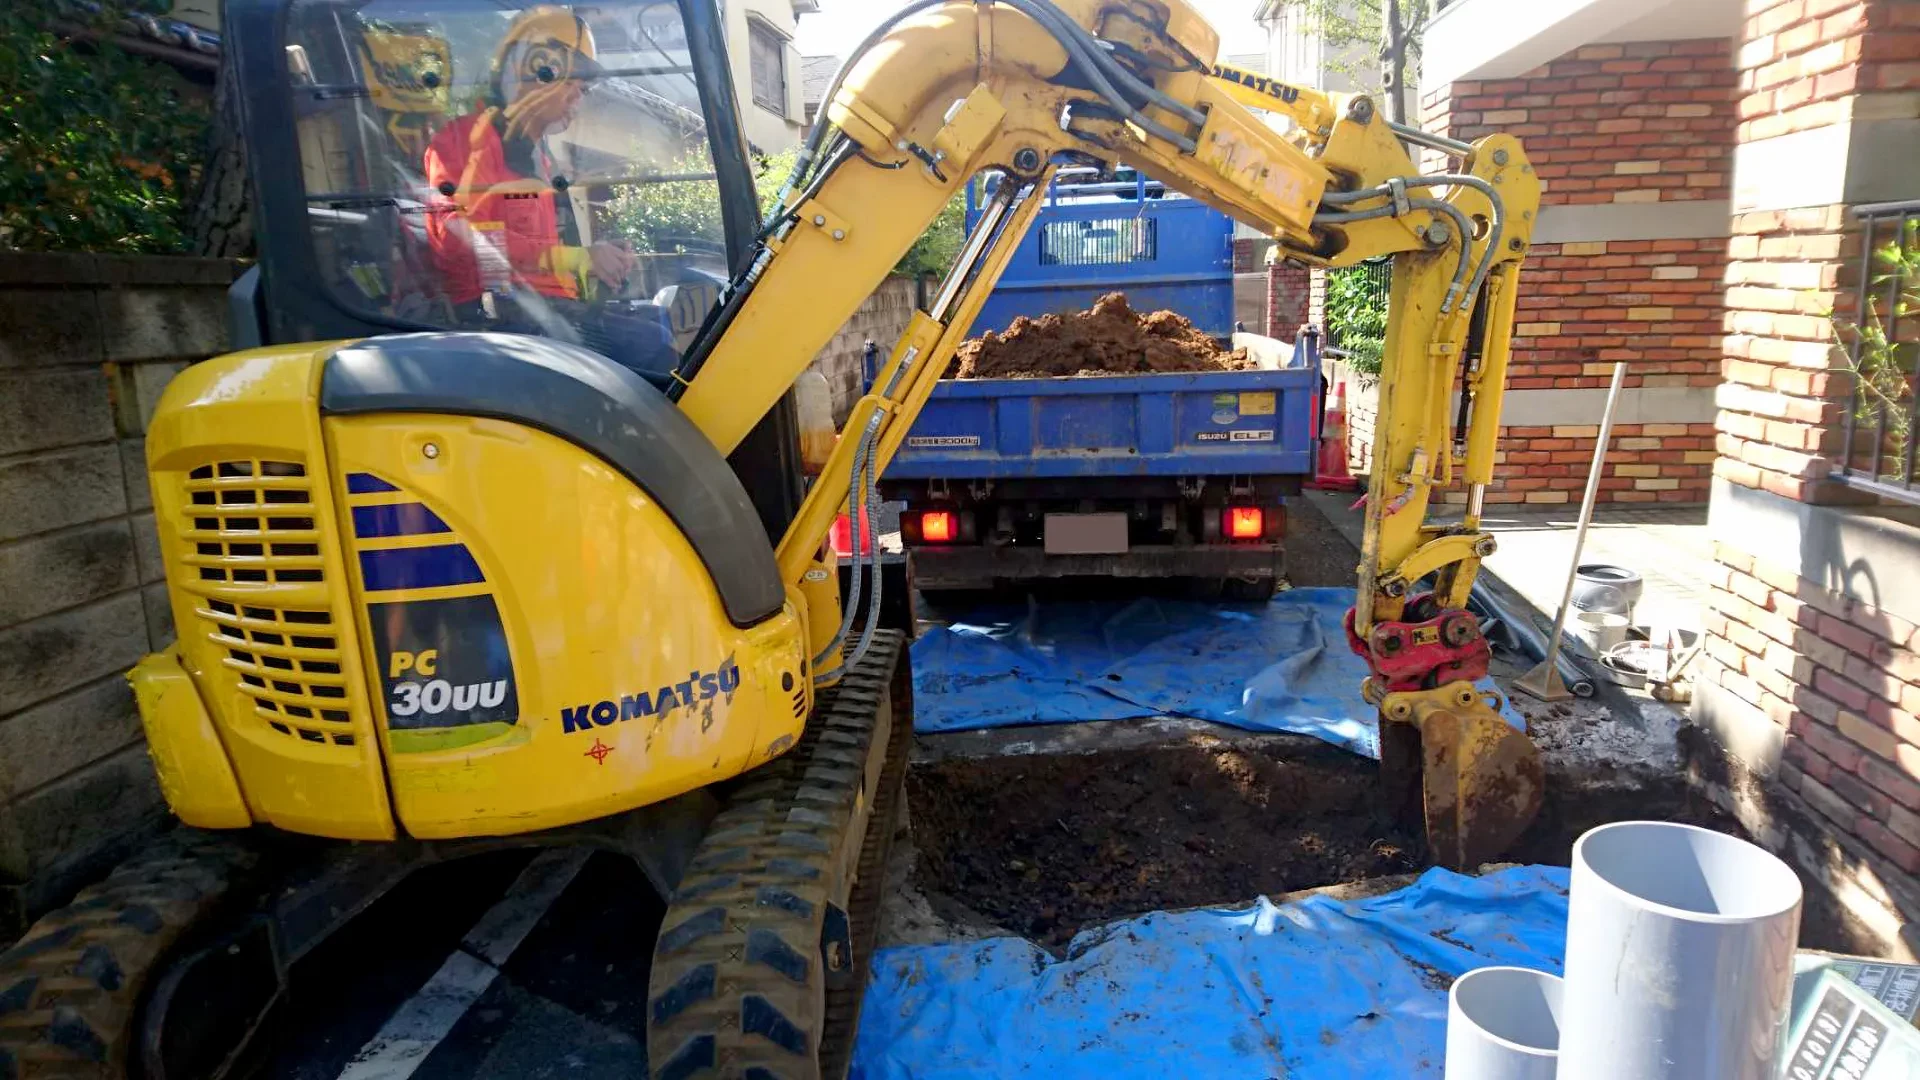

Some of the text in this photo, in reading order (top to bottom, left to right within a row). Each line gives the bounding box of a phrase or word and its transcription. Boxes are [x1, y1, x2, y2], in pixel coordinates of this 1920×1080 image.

[1198, 432, 1227, 440] ISUZU
[389, 649, 438, 678] PC
[560, 665, 740, 734] KOMATSU
